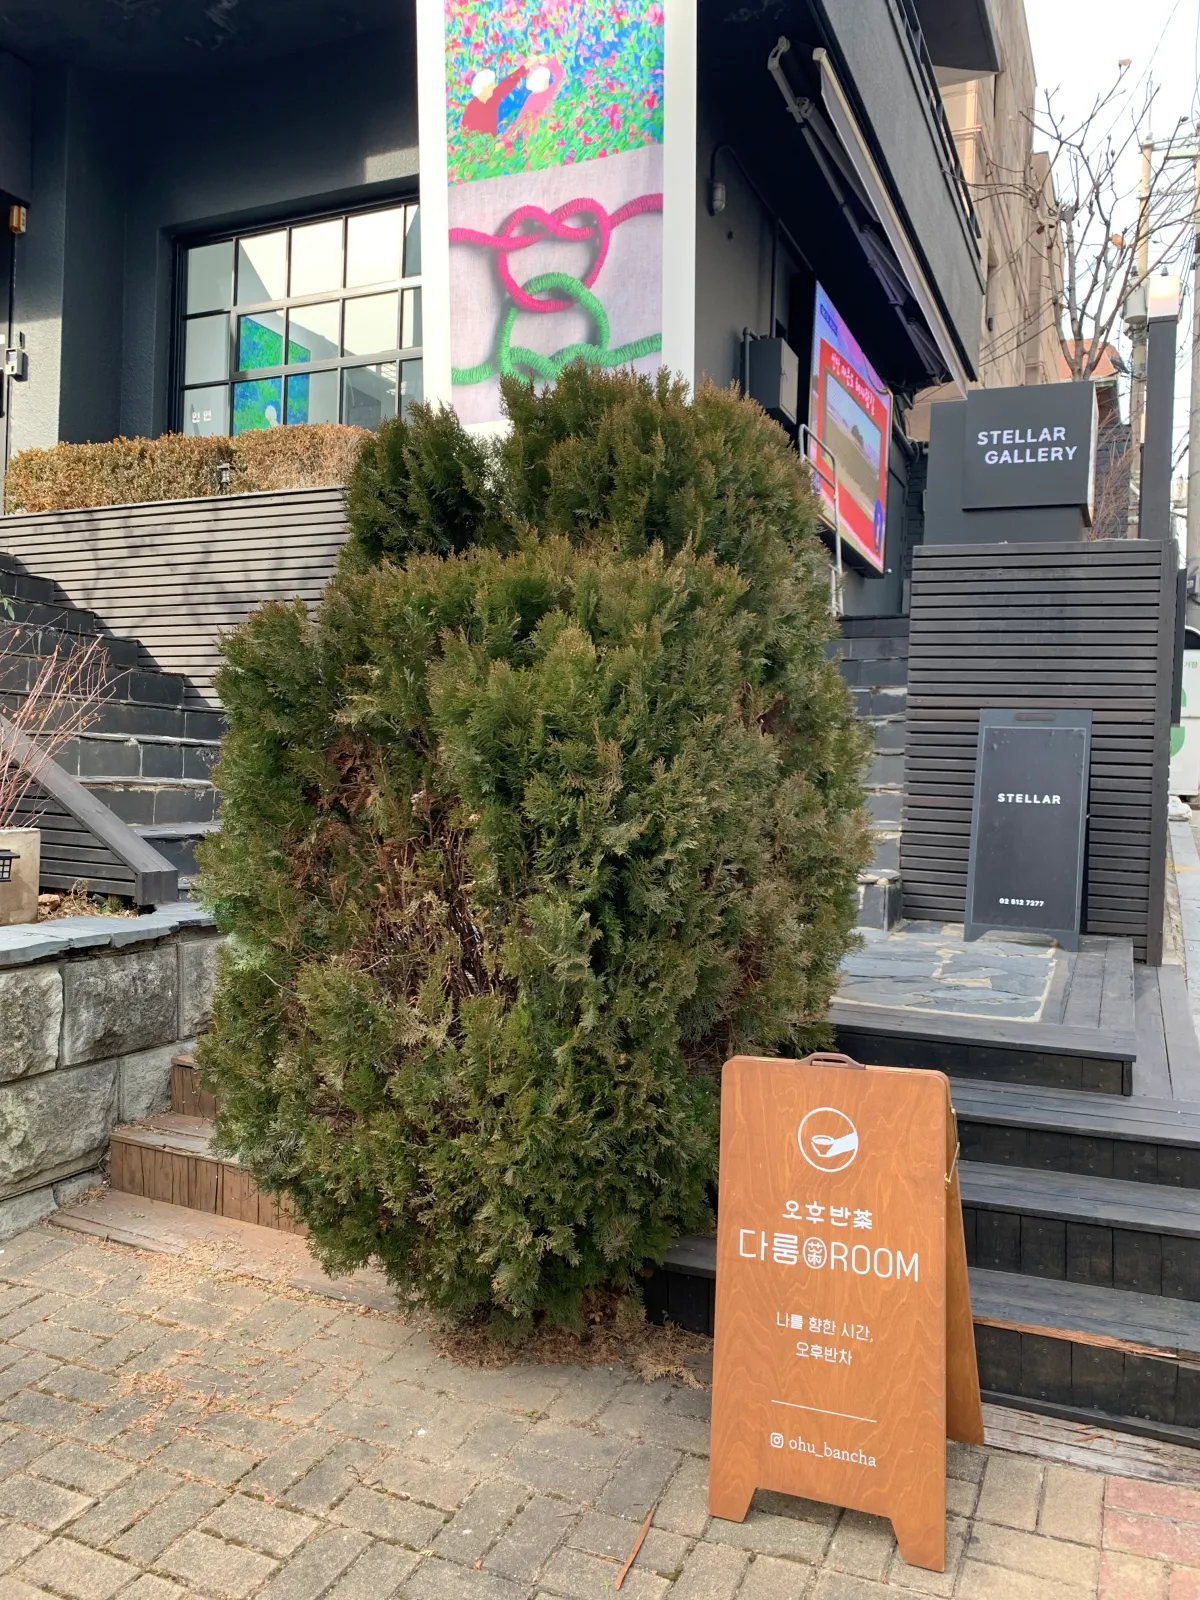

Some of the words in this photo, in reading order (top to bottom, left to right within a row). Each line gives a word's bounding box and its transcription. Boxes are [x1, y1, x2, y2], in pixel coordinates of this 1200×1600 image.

[976, 426, 1067, 446] STELLAR
[984, 445, 1078, 465] GALLERY
[997, 792, 1062, 805] STELLAR
[998, 897, 1010, 905] 02
[1025, 899, 1045, 907] 7277
[830, 1241, 920, 1283] ROOM
[775, 1311, 804, 1331] 나를
[808, 1316, 837, 1336] 향한
[841, 1322, 874, 1343] 시간,
[795, 1341, 853, 1366] 오후반차
[788, 1436, 878, 1468] ohu_bancha
